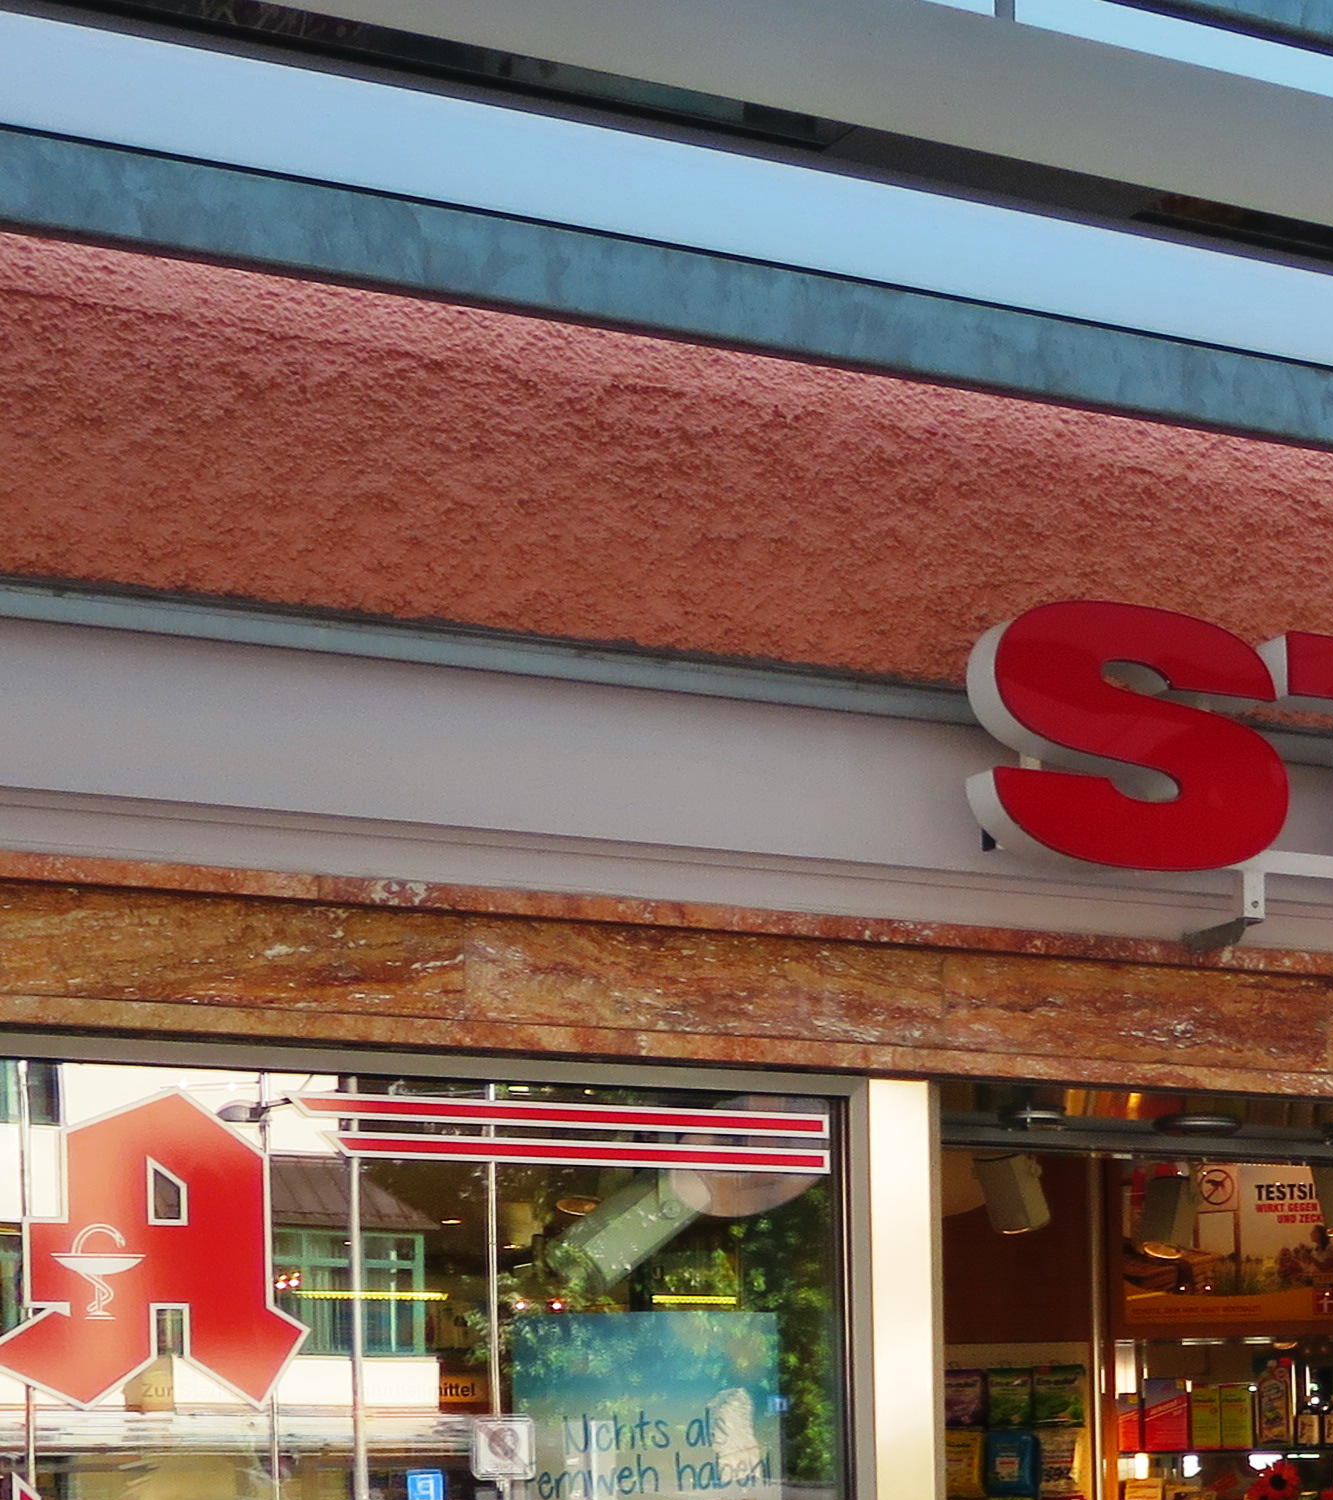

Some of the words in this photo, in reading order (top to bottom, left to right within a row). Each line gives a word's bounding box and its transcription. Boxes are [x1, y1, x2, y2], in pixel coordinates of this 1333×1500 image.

[1256, 1203, 1285, 1213] WIRKT
[1288, 1203, 1318, 1212] GEGEN
[1277, 1214, 1296, 1224] UND
[563, 1408, 670, 1453] Nichts
